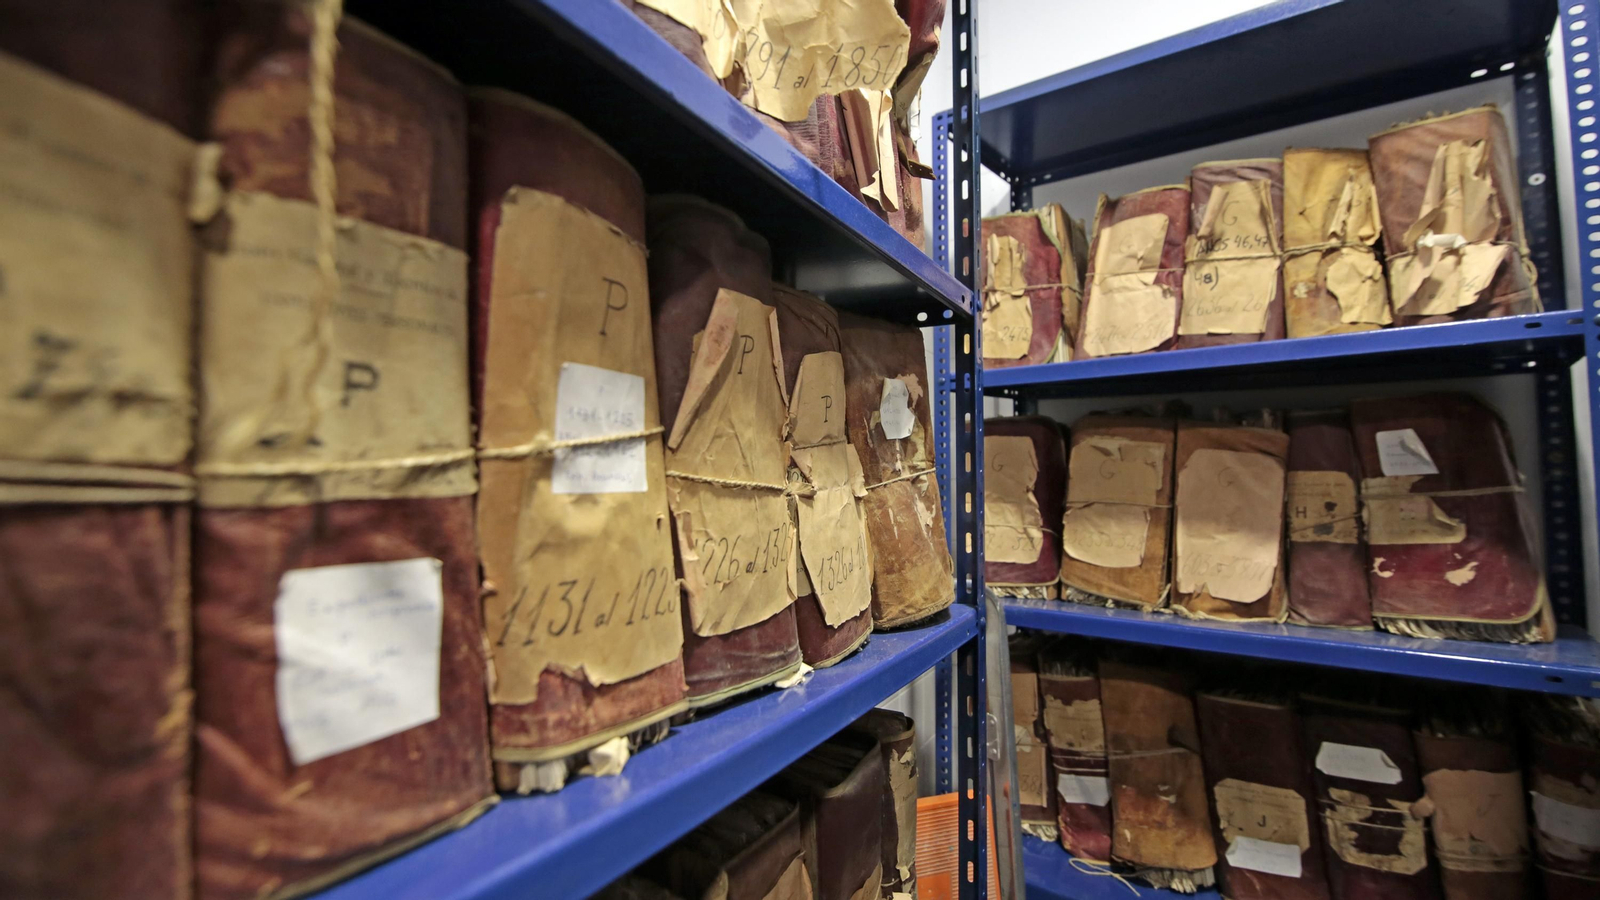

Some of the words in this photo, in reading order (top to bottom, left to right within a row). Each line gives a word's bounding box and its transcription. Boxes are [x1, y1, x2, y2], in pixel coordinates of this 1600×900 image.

[821, 43, 904, 88] 1850
[599, 277, 629, 336] P
[737, 335, 755, 375] P
[340, 360, 381, 407] P
[821, 395, 833, 423] P
[1295, 506, 1308, 519] H
[817, 546, 848, 597] 1326
[495, 574, 597, 647] 1131
